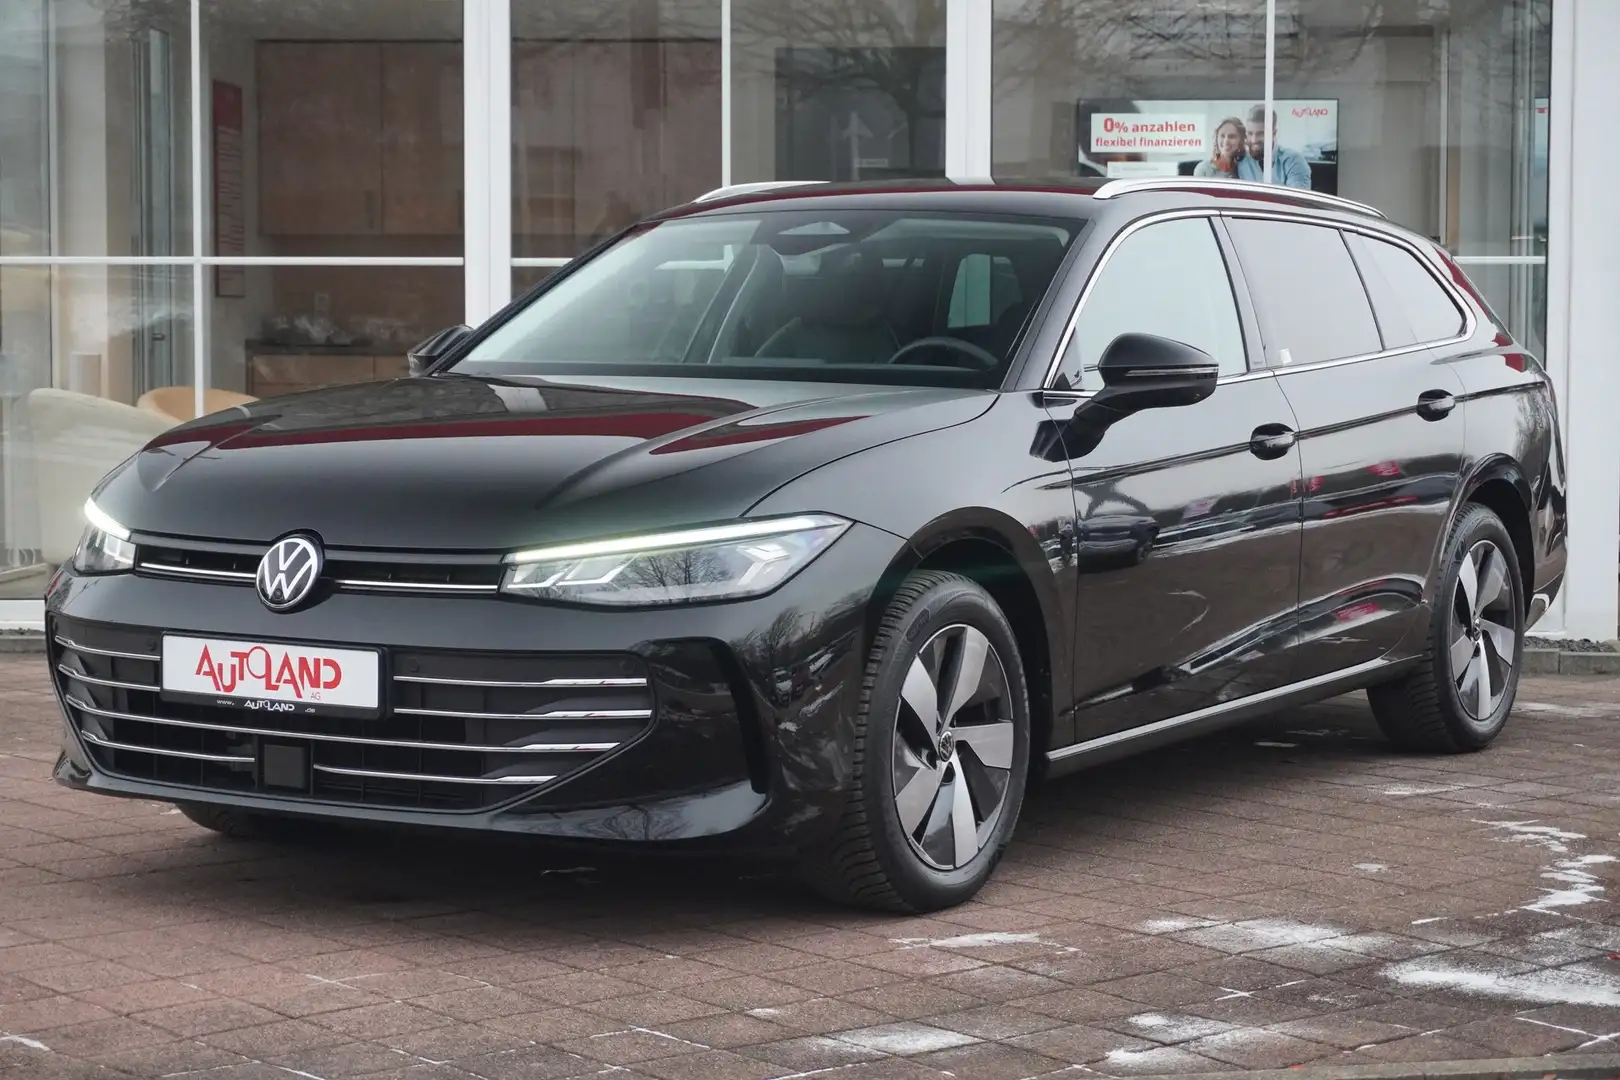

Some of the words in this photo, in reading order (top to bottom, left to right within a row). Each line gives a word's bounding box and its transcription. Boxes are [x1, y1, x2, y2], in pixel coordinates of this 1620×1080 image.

[1103, 117, 1128, 133] 0%
[1132, 120, 1196, 133] anzahlen
[1095, 137, 1137, 147] flexibel
[1139, 137, 1202, 148] finanzieren
[310, 692, 321, 701] AG
[216, 698, 235, 706] www.
